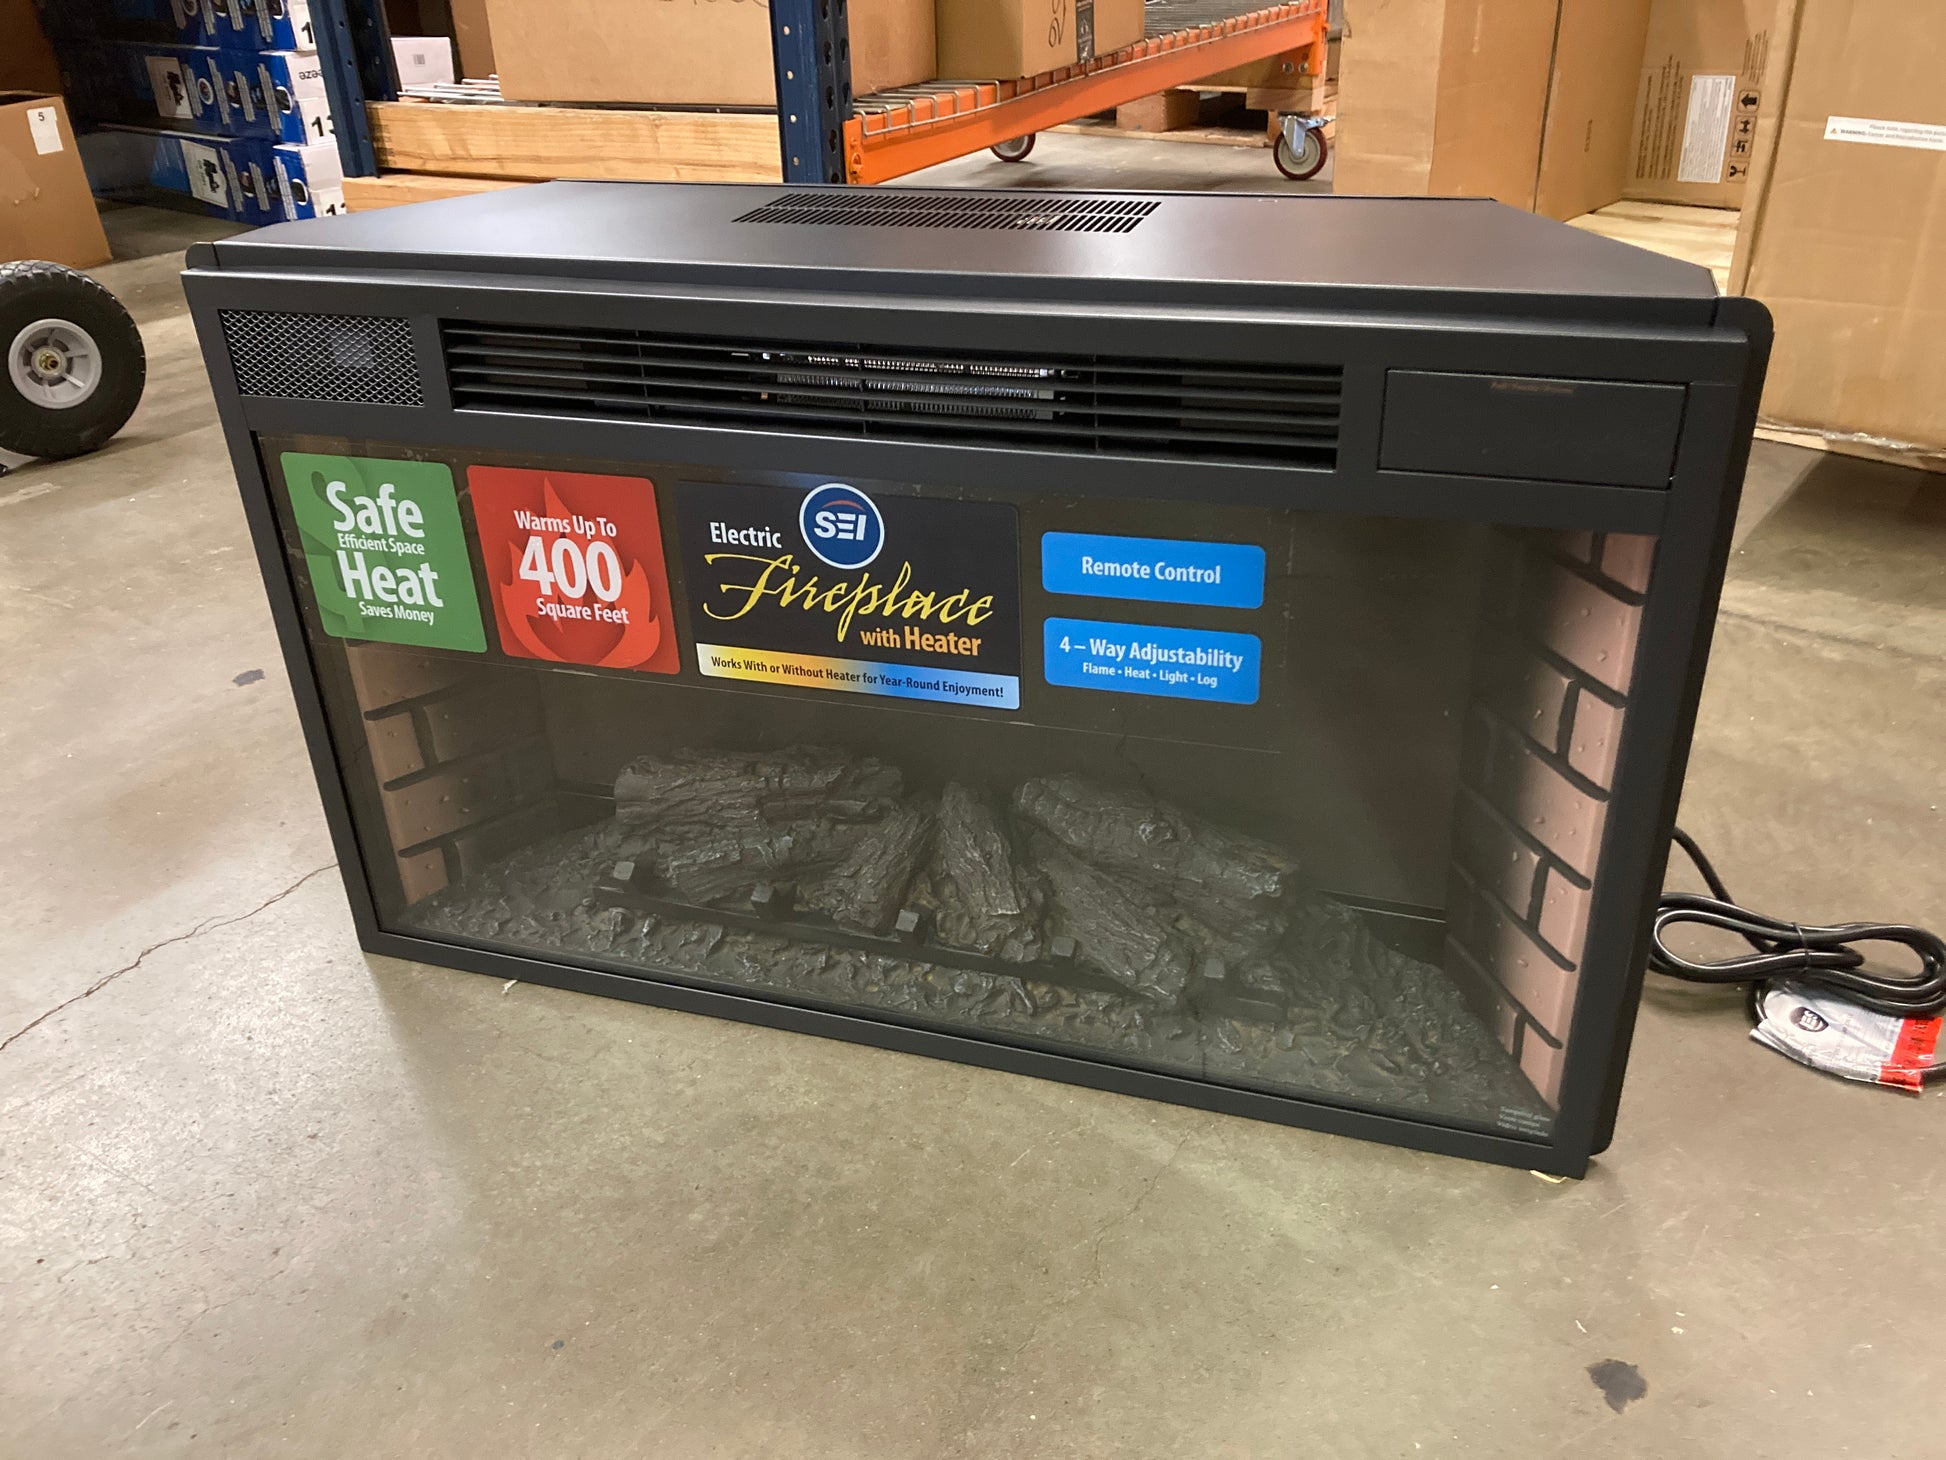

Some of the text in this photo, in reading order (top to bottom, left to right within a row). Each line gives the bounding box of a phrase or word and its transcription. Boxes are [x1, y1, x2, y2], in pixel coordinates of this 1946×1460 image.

[38, 112, 44, 121] 5
[326, 481, 424, 538] Safe
[514, 510, 617, 539] Warms Up To
[710, 521, 782, 550] Electric
[814, 510, 866, 541] SEI
[338, 533, 425, 556] Efficient Space
[336, 550, 443, 608] Heat
[519, 535, 622, 603] 400
[1082, 556, 1221, 584] Remote Control
[537, 598, 629, 625] Square Feet
[702, 553, 994, 642] Fireplace
[359, 602, 434, 626] Saves Money
[860, 626, 981, 656] with Heater
[1059, 636, 1070, 653] 4
[1089, 638, 1126, 660] Way
[1128, 642, 1244, 671] Adjustability
[711, 656, 1004, 699] Works With or Without Heater for Year-Round Enjoyment!
[1082, 662, 1218, 688] Flame Heat Light Log
